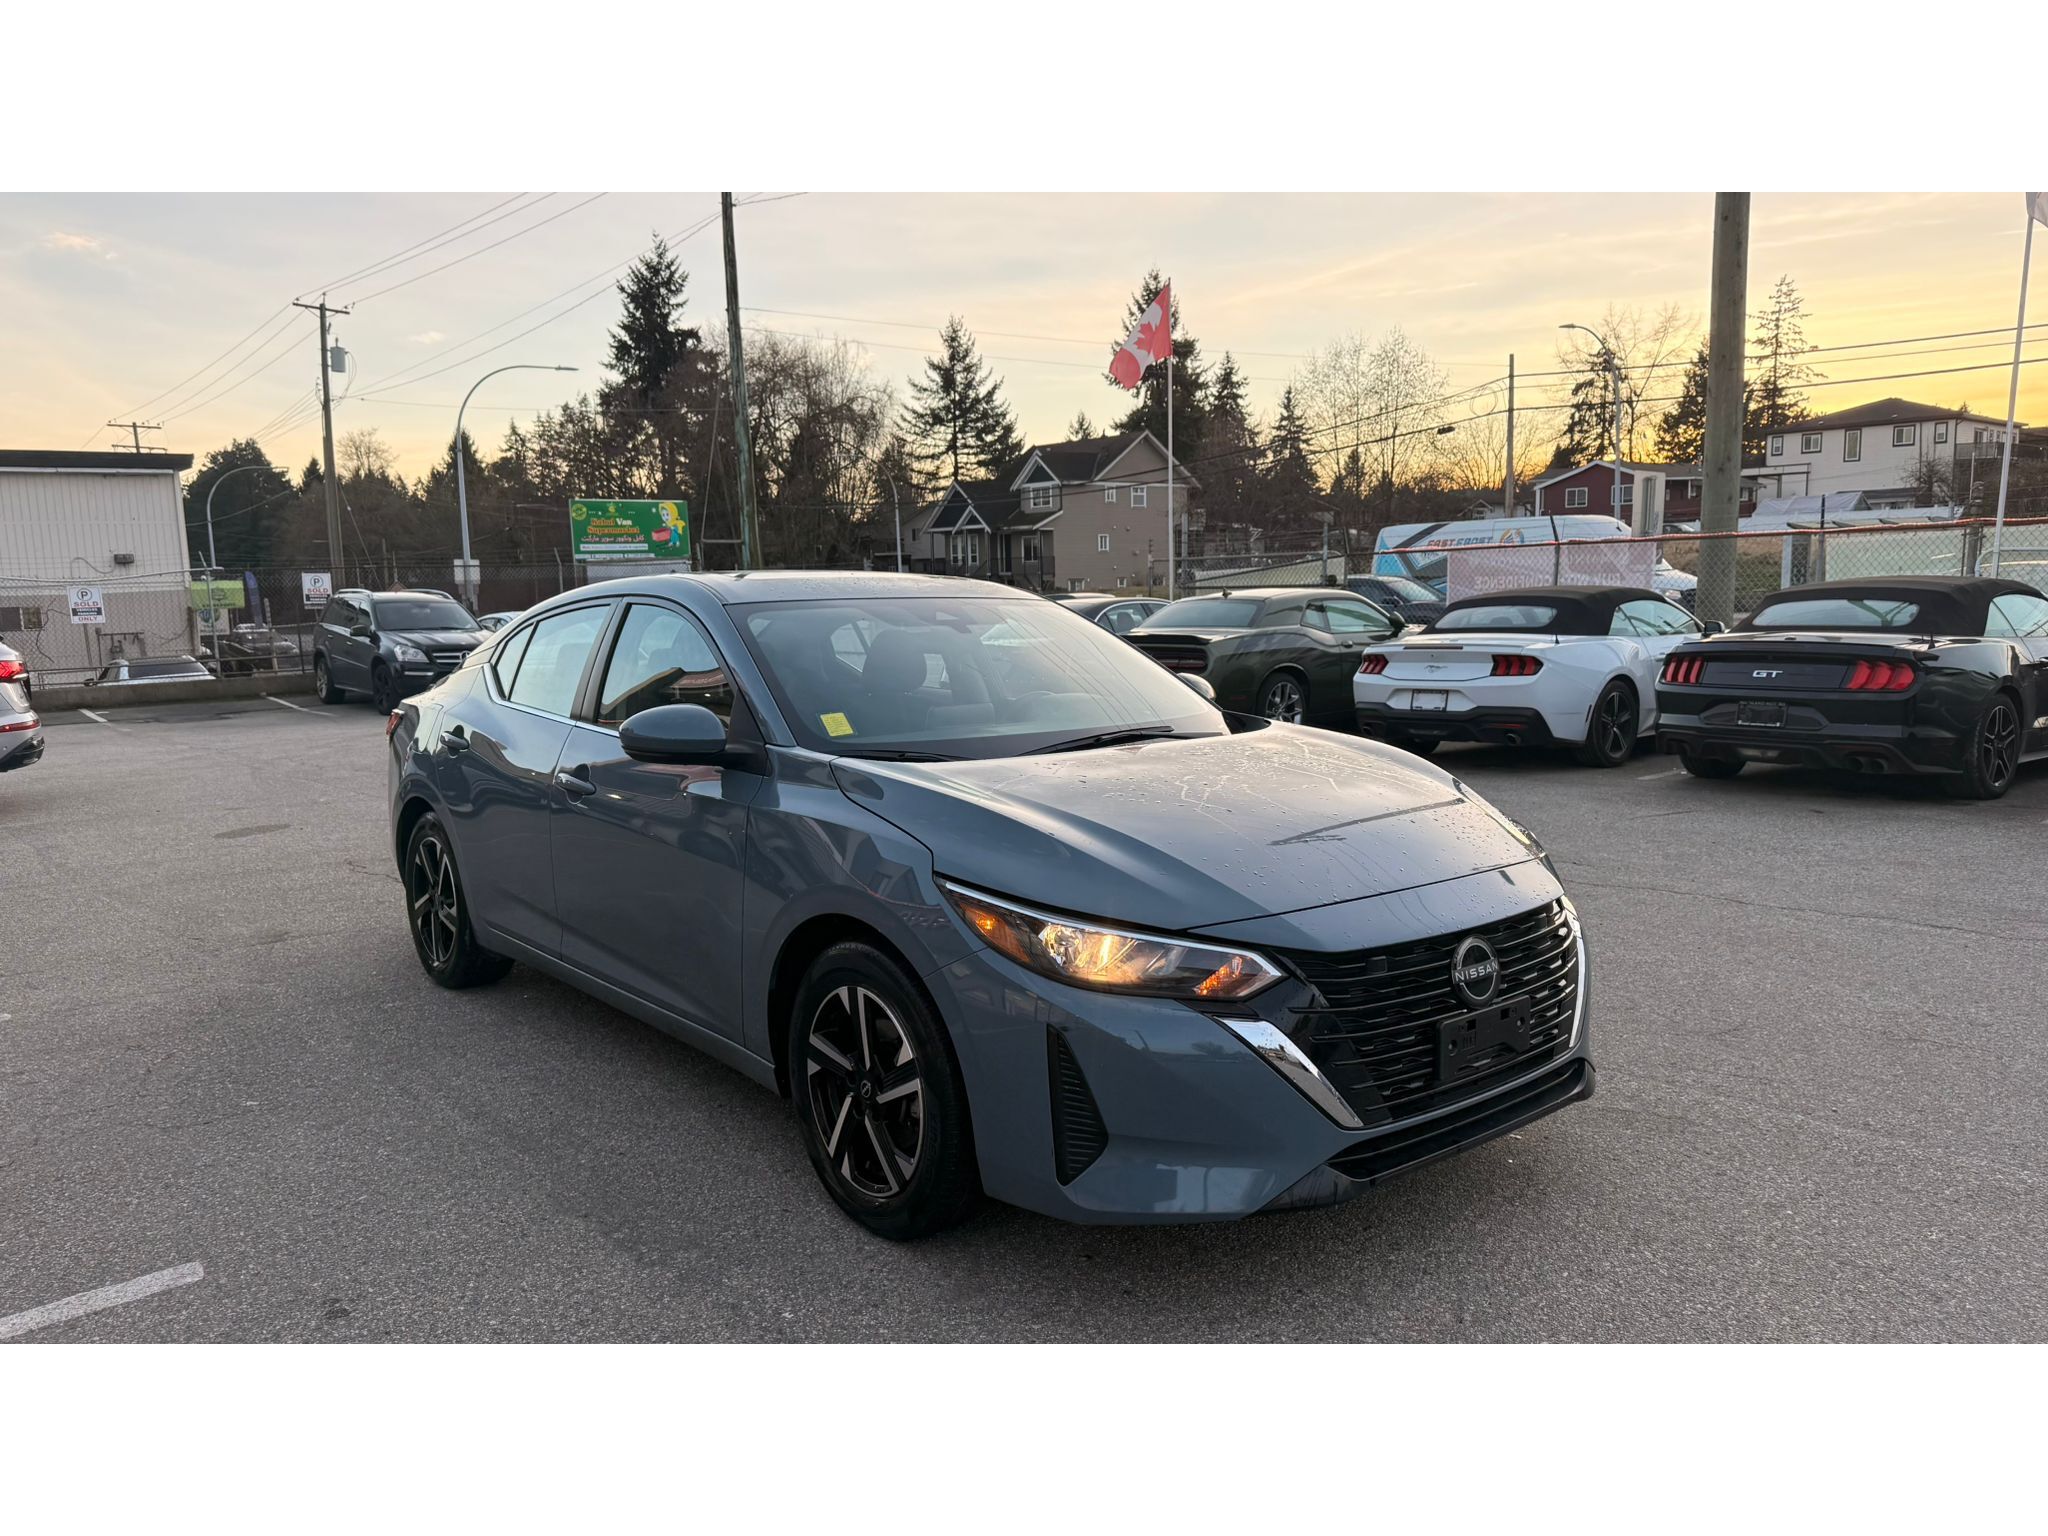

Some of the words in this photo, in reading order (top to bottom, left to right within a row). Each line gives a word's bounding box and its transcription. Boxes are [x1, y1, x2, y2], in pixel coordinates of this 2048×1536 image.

[616, 518, 632, 526] Van
[1752, 669, 1784, 678] GT
[1455, 961, 1498, 981] NISSAN
